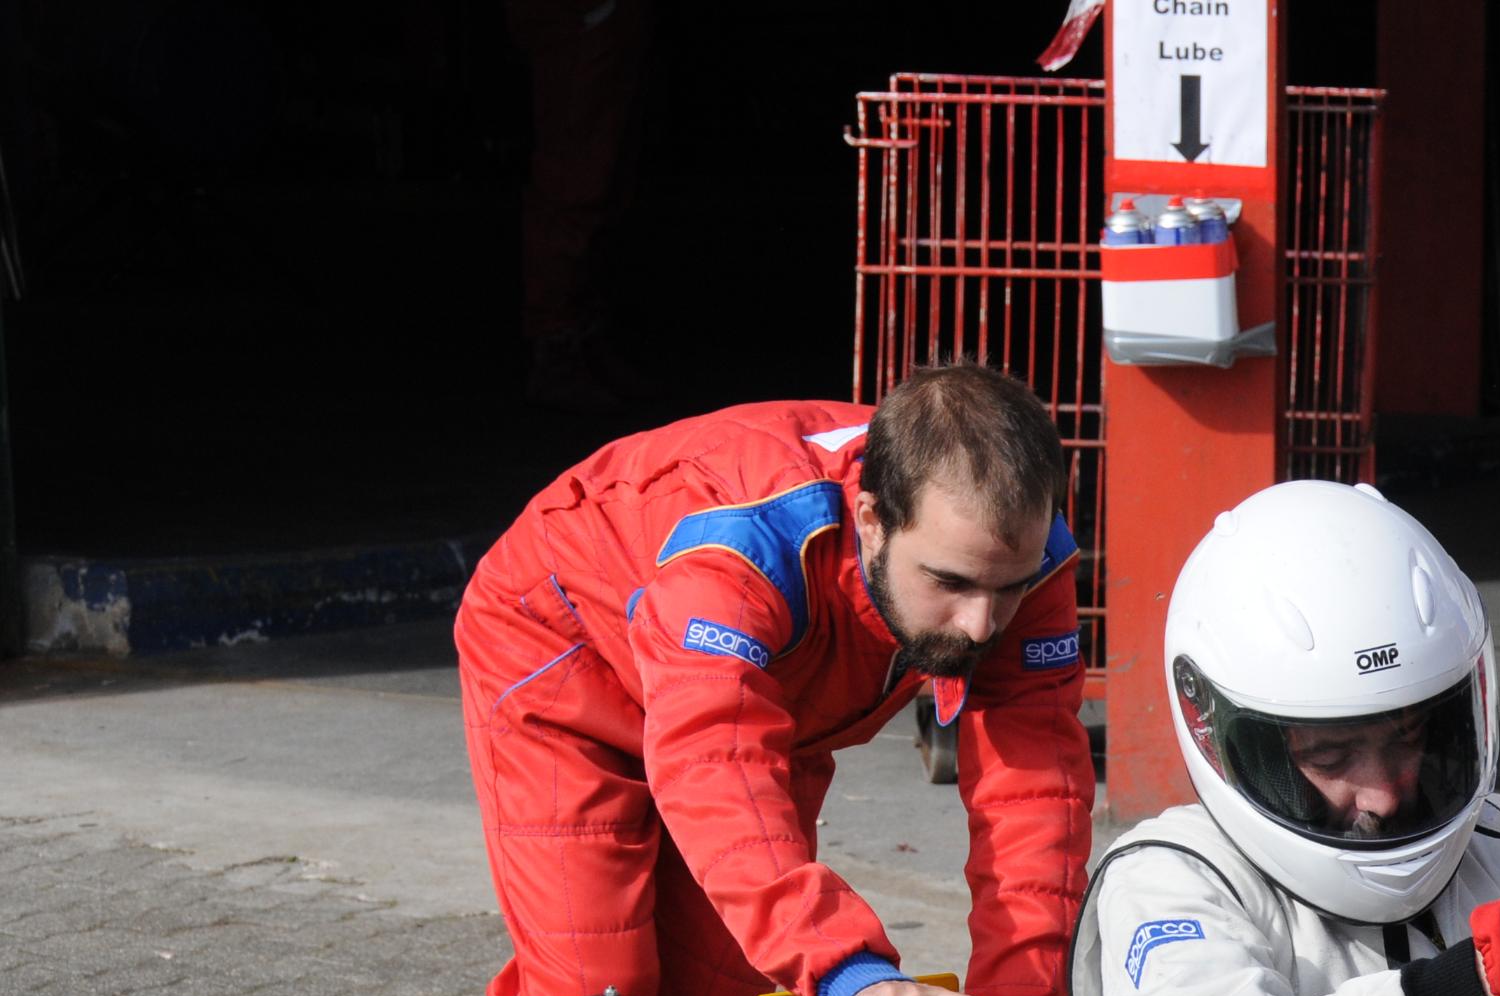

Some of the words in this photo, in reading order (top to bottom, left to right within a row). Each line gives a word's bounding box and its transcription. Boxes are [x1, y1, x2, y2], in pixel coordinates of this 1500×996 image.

[1153, 0, 1229, 15] Chain
[1158, 41, 1224, 61] Lube
[686, 623, 769, 668] sparco
[1025, 636, 1078, 664] spar
[1356, 647, 1399, 670] OMP
